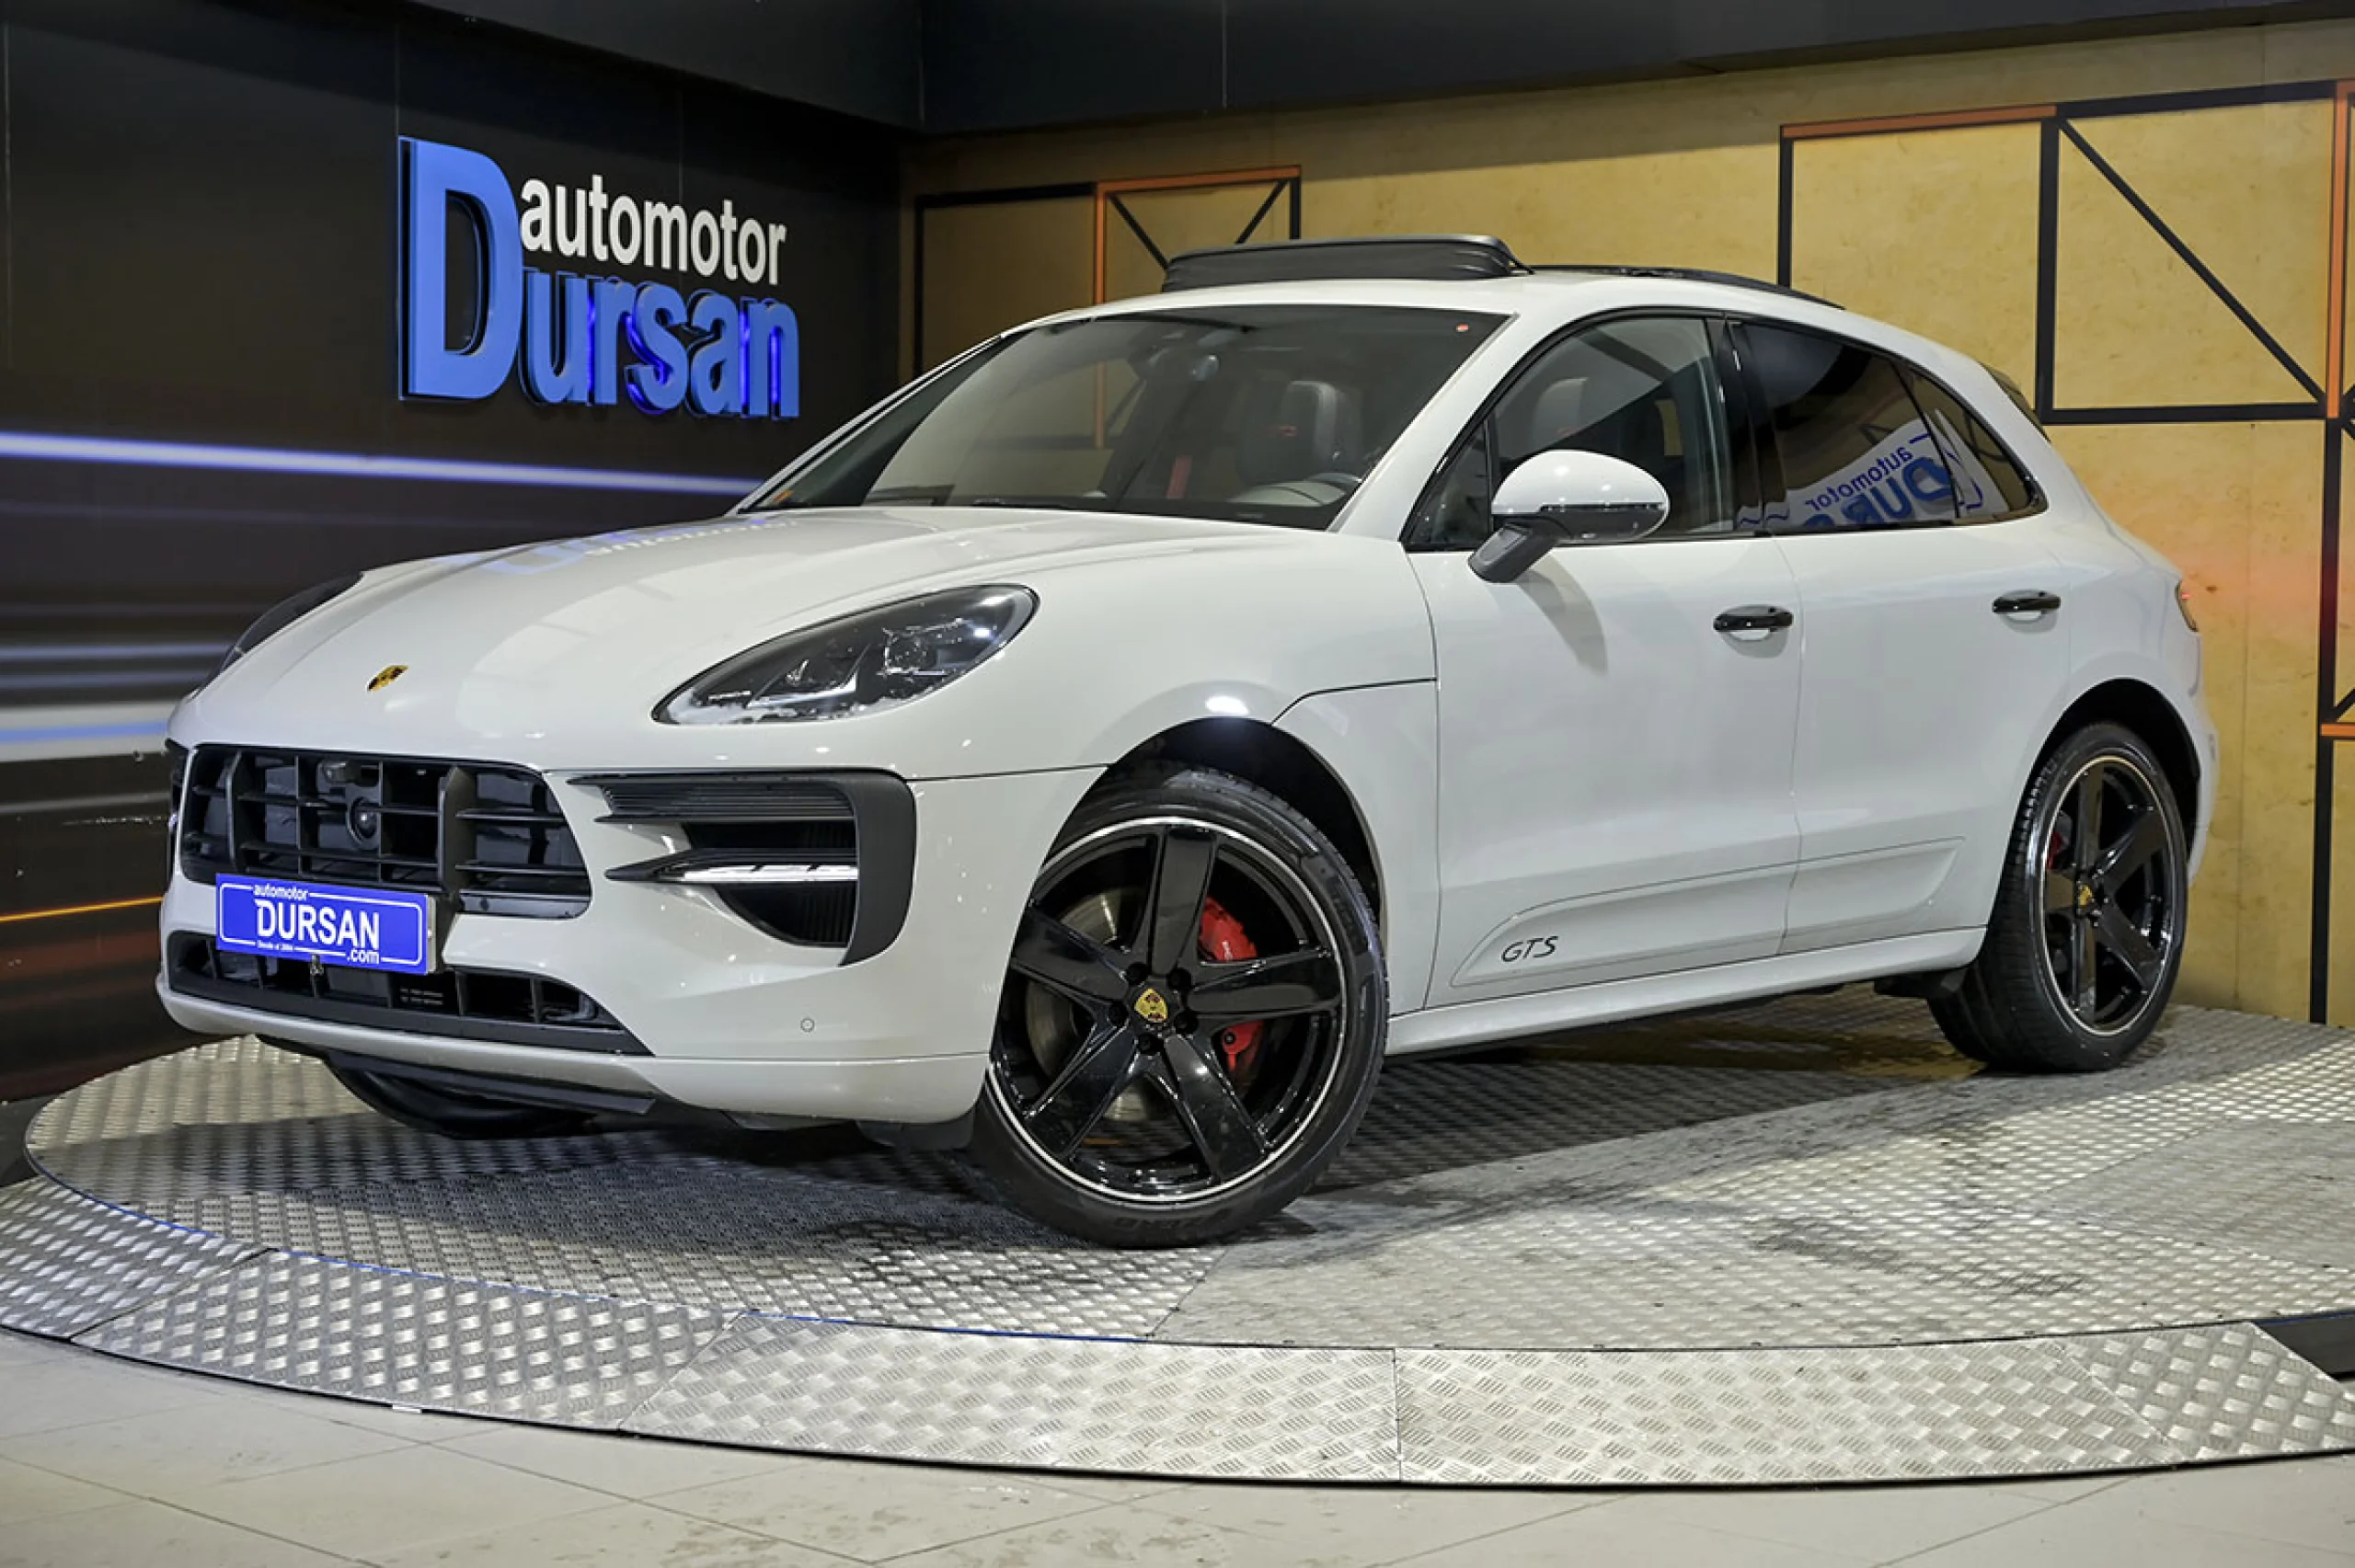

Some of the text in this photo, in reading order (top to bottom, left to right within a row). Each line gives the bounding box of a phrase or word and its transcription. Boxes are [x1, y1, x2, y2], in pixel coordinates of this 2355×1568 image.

[520, 174, 787, 286] automotor
[397, 134, 799, 418] Dursan
[252, 883, 309, 901] automotor
[254, 898, 380, 950] DURSAN
[346, 948, 380, 965] .com
[1500, 935, 1559, 963] GTS
